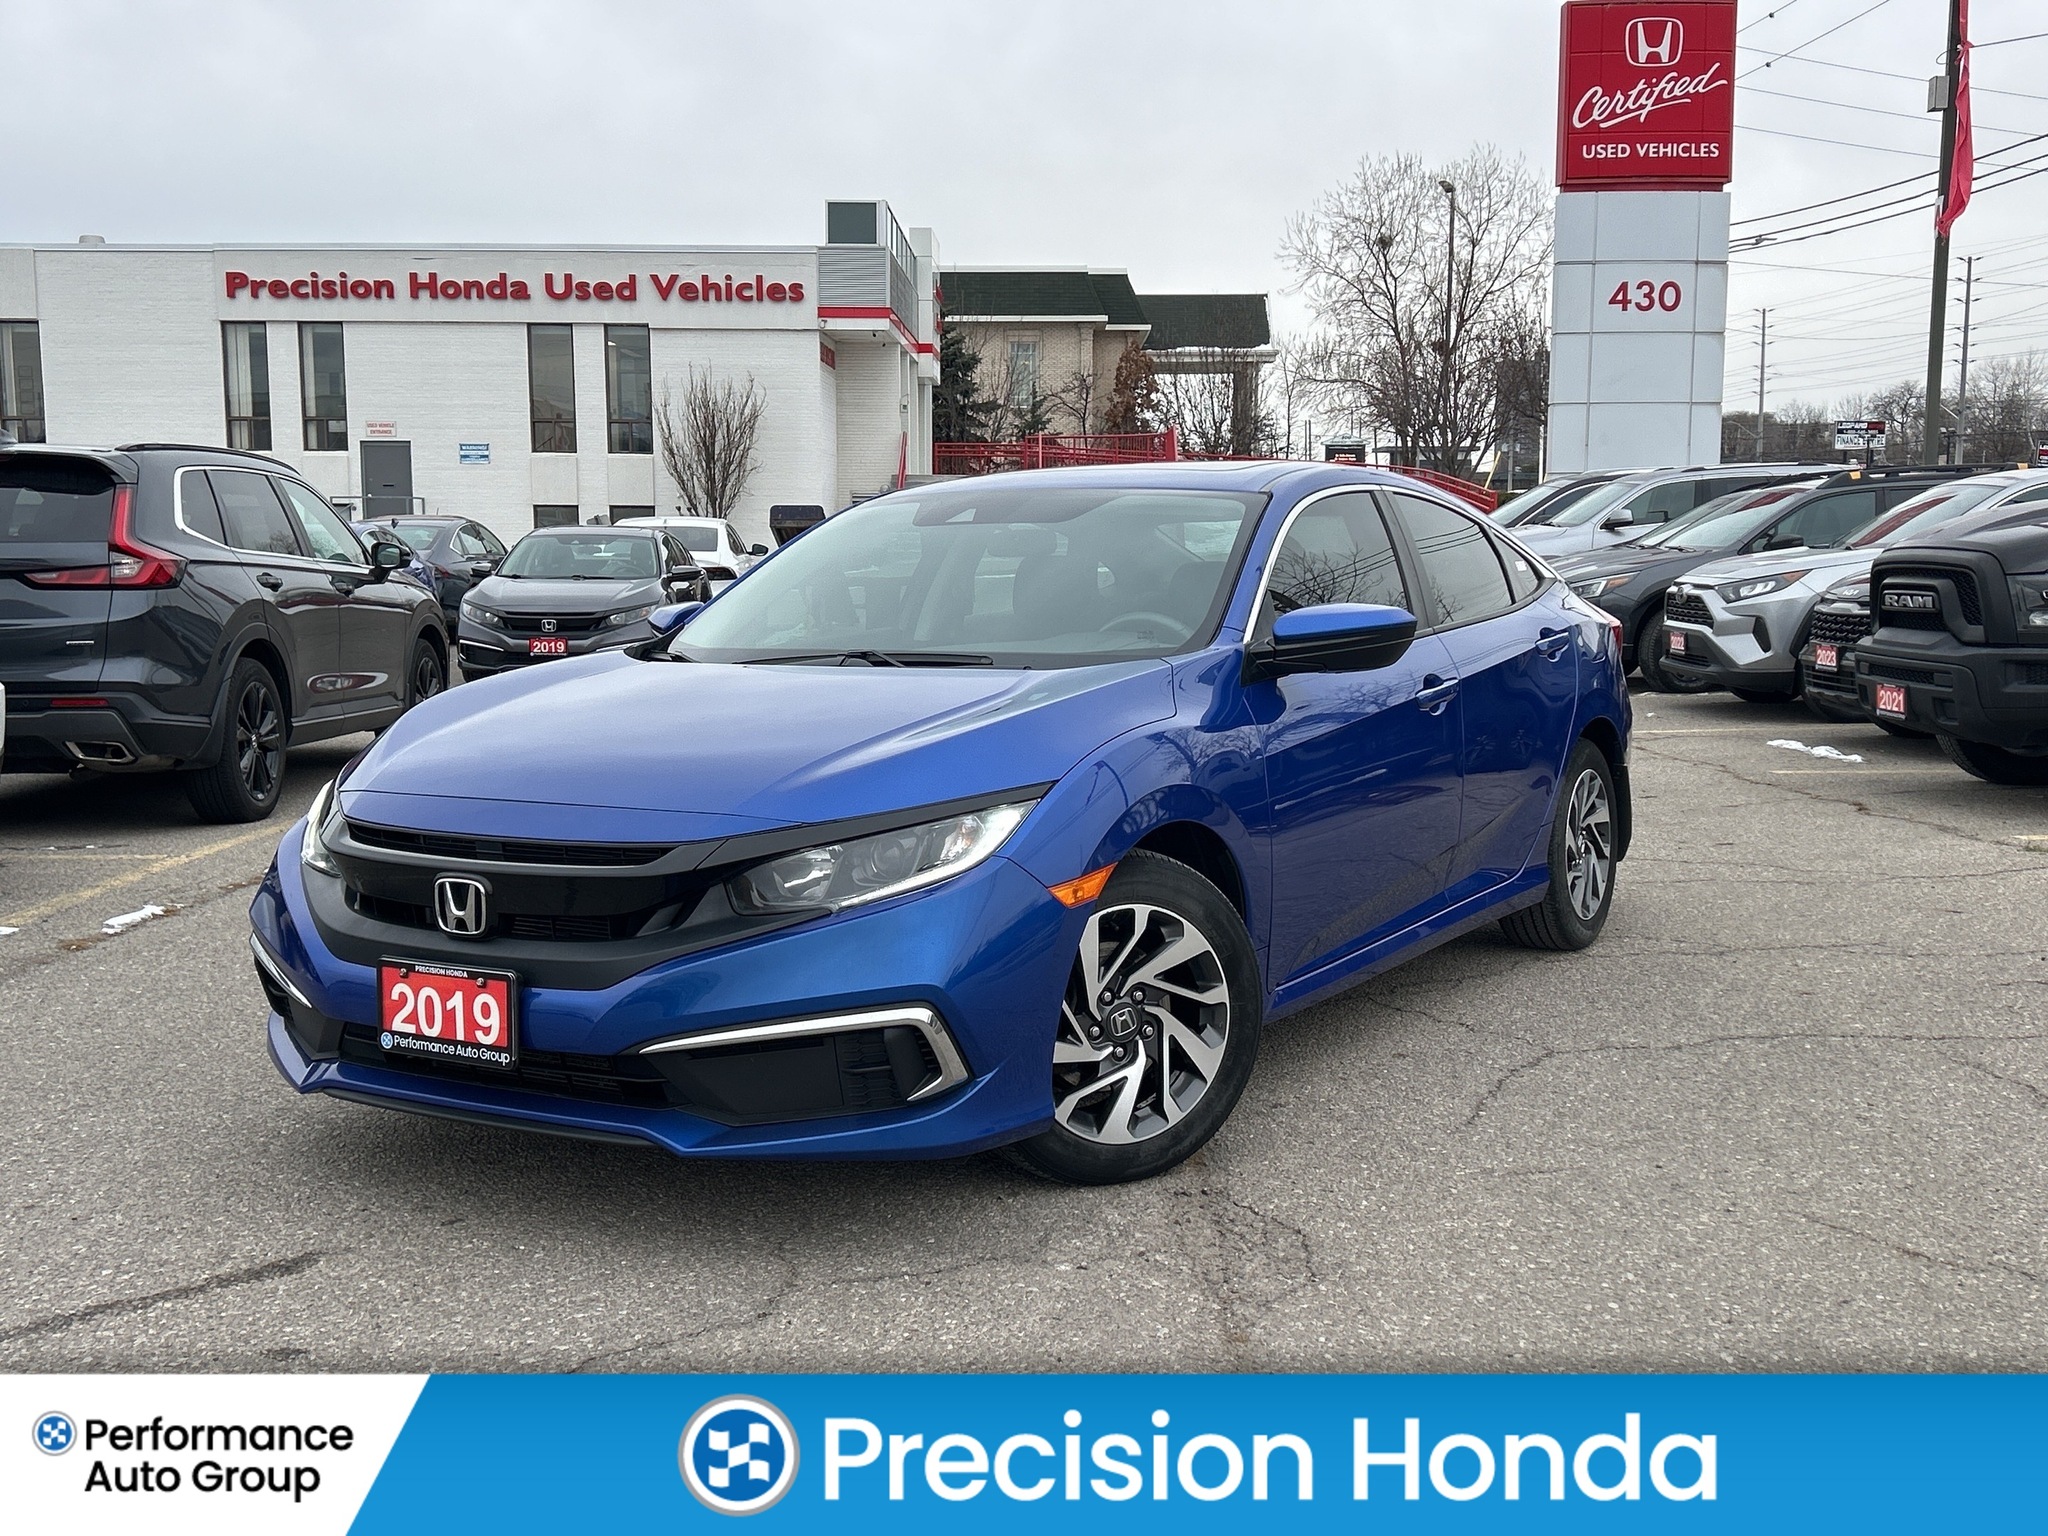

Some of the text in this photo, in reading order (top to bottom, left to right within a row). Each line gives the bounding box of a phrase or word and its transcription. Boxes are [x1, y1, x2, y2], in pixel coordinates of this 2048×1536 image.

[1573, 63, 1728, 128] Certified
[1582, 143, 1720, 159] USED VEHICLES
[225, 271, 805, 302] Precision Honda Used Vehicles
[1608, 280, 1682, 312] 430
[1884, 594, 1933, 608] RAM
[533, 641, 564, 652] 2019
[1816, 649, 1836, 666] 2023
[1879, 690, 1905, 713] 2021
[415, 965, 469, 979] PRECISION HONDA
[390, 982, 501, 1046] 2019
[394, 1035, 510, 1066] Performance Auto Group
